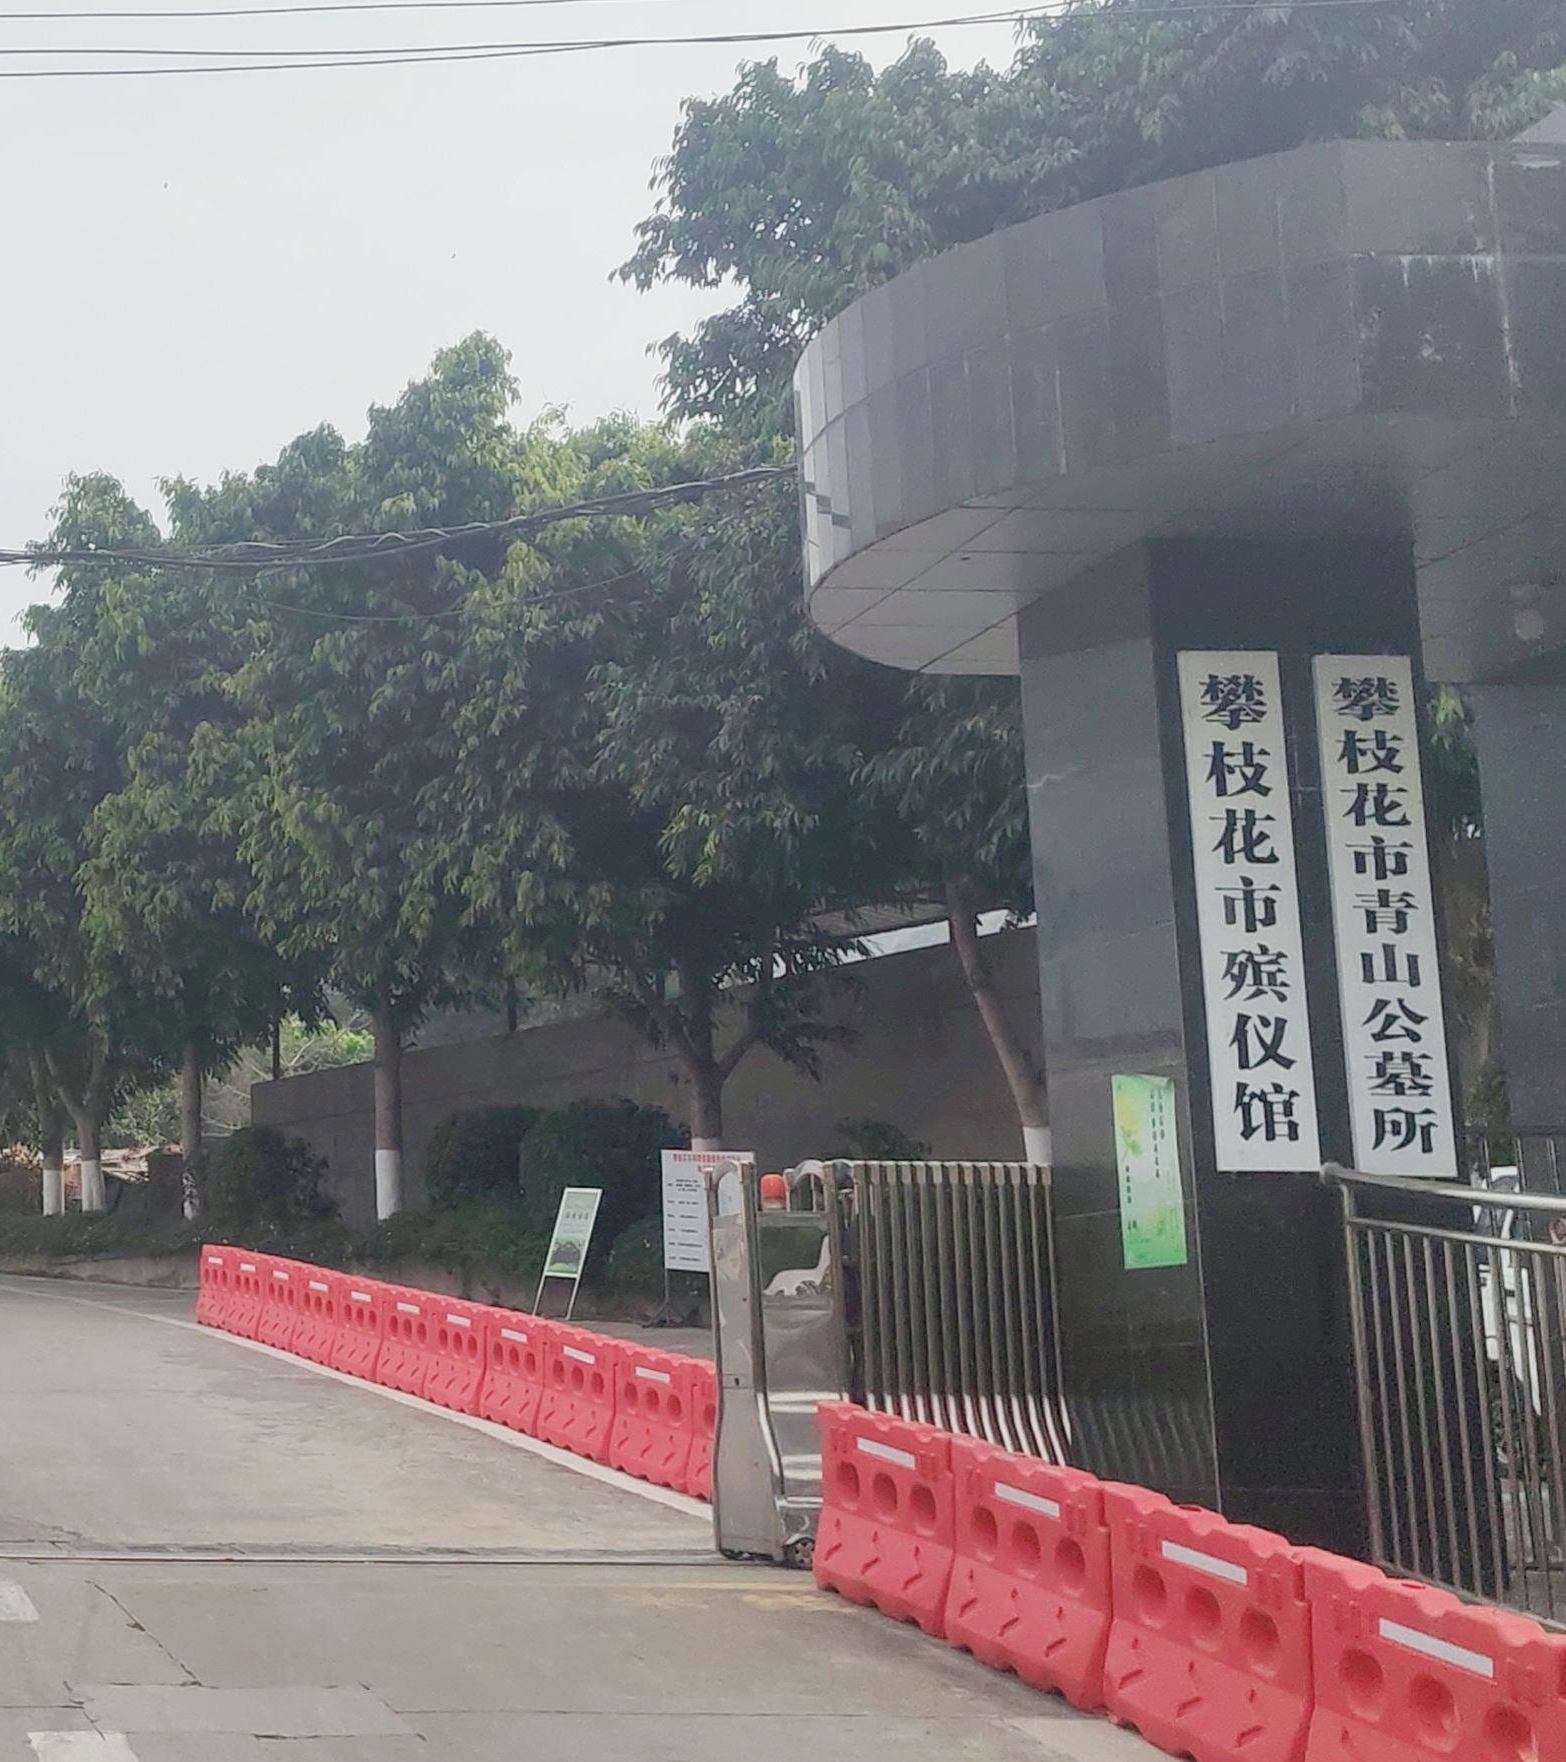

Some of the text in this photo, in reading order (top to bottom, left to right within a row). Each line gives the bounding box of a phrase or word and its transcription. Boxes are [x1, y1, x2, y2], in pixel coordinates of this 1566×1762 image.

[1199, 673, 1301, 1143] 攀枝花市殡仪馆
[1331, 676, 1438, 1154] 攀枝花市青山公墓所
